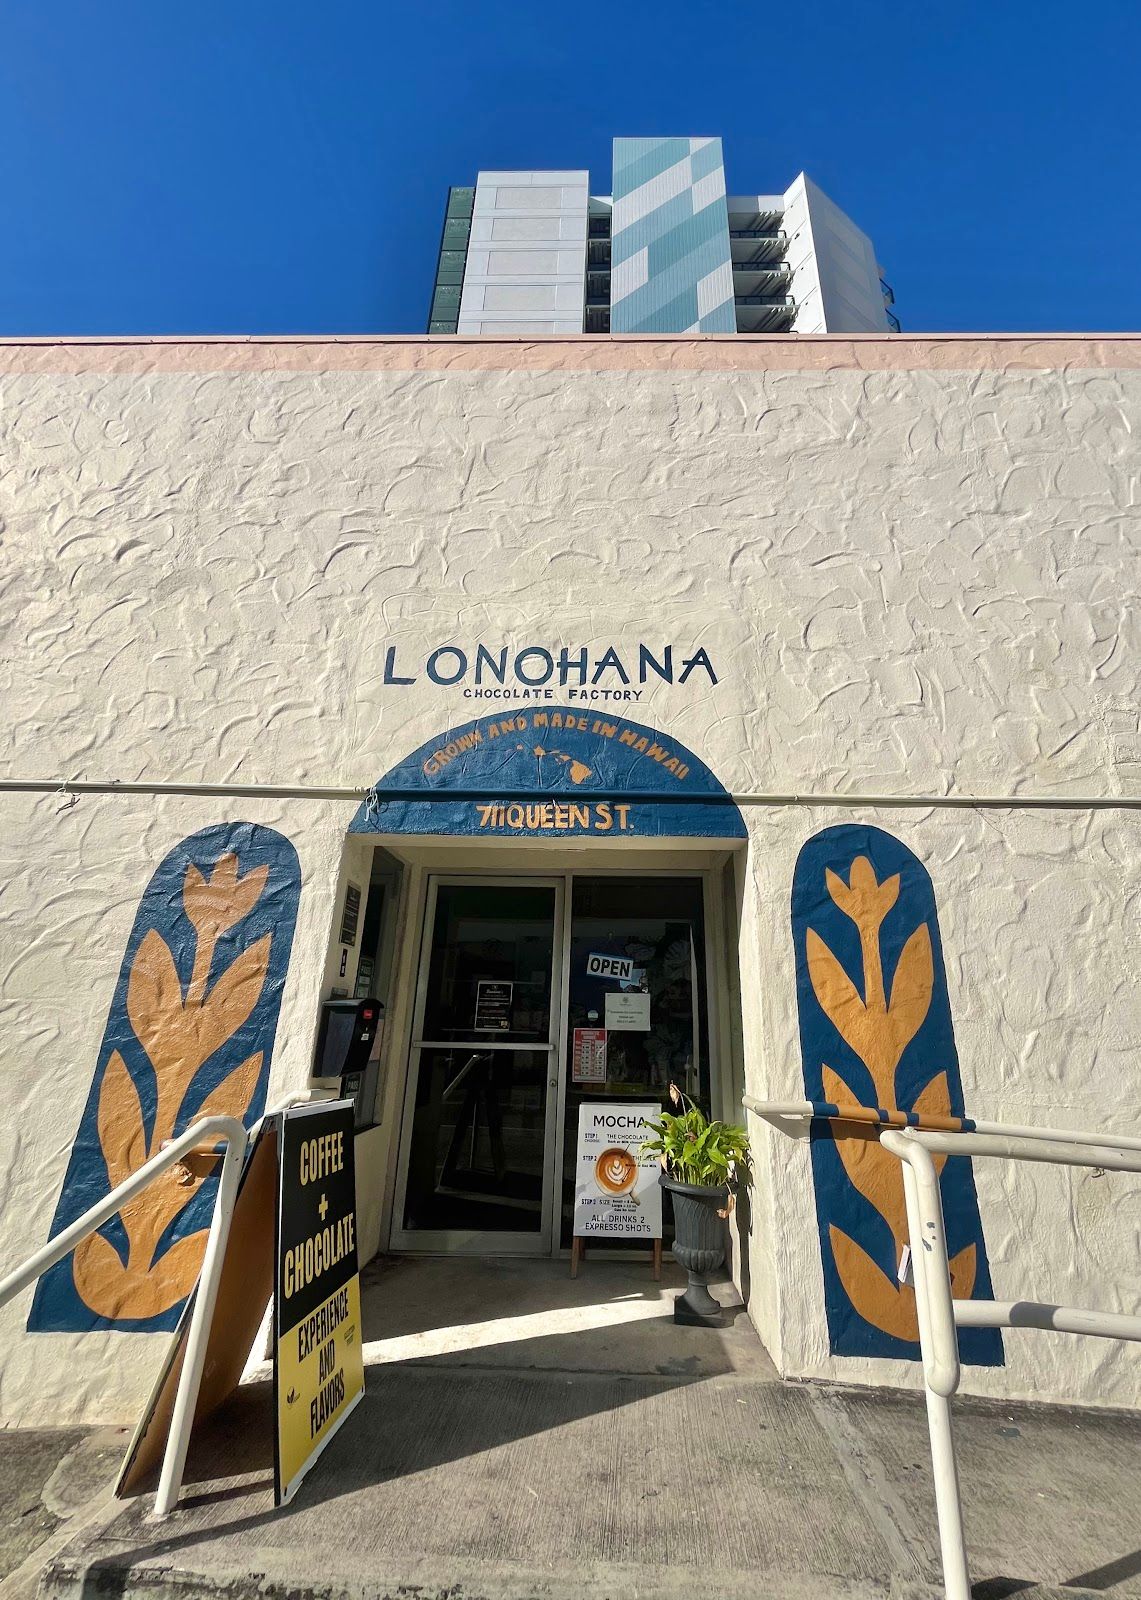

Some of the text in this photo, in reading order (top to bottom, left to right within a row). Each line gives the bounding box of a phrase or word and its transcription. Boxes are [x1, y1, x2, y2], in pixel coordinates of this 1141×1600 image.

[384, 643, 718, 686] LONOHANA
[463, 688, 643, 701] CHOCOLATE FACTORY
[423, 712, 690, 780] GROWN AND MADE IN HAWAII
[506, 804, 590, 830] QUEEN
[594, 803, 635, 830] ST.
[590, 957, 631, 978] OPEN
[593, 1115, 647, 1129] MOCHA
[300, 1131, 344, 1186] COFFEE
[318, 1193, 329, 1221] +
[591, 1214, 645, 1224] ALL DRINKS 2
[585, 1222, 651, 1232] EXPRESSO SHOTS
[284, 1212, 355, 1299] CHOCOLATE
[298, 1287, 350, 1364] EXPERIENCE
[319, 1338, 336, 1387] AND
[310, 1367, 346, 1440] FLAVORS
